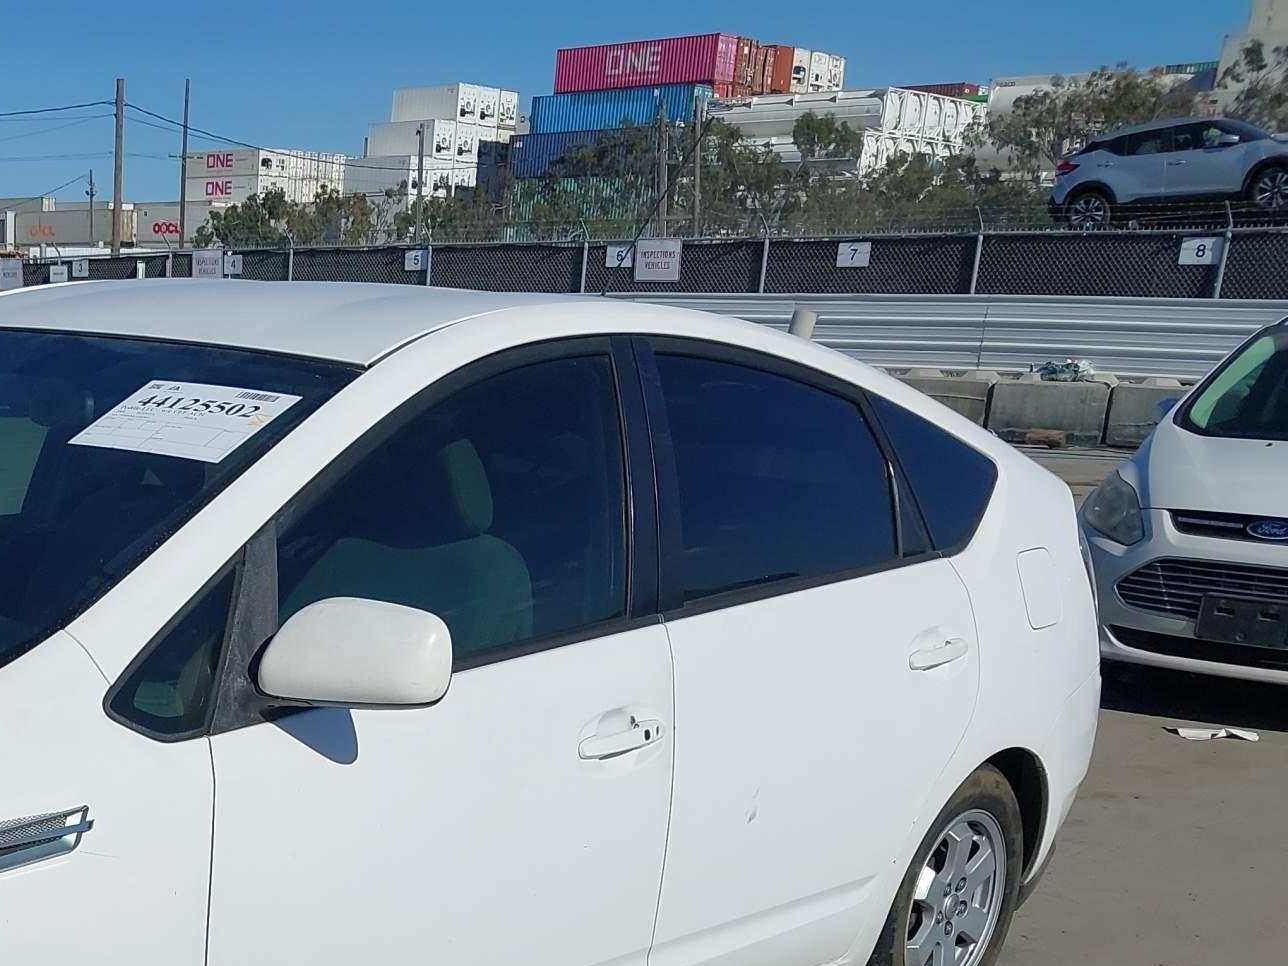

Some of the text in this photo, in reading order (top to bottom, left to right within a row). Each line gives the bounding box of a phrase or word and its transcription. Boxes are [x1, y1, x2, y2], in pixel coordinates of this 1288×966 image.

[606, 45, 661, 75] ONE
[206, 153, 233, 168] ONE
[205, 181, 232, 196] ONE
[616, 250, 625, 262] 6
[850, 248, 858, 261] 7
[1195, 244, 1206, 258] 8
[230, 259, 237, 270] 4
[413, 254, 420, 266] 5
[138, 394, 261, 418] 44125502
